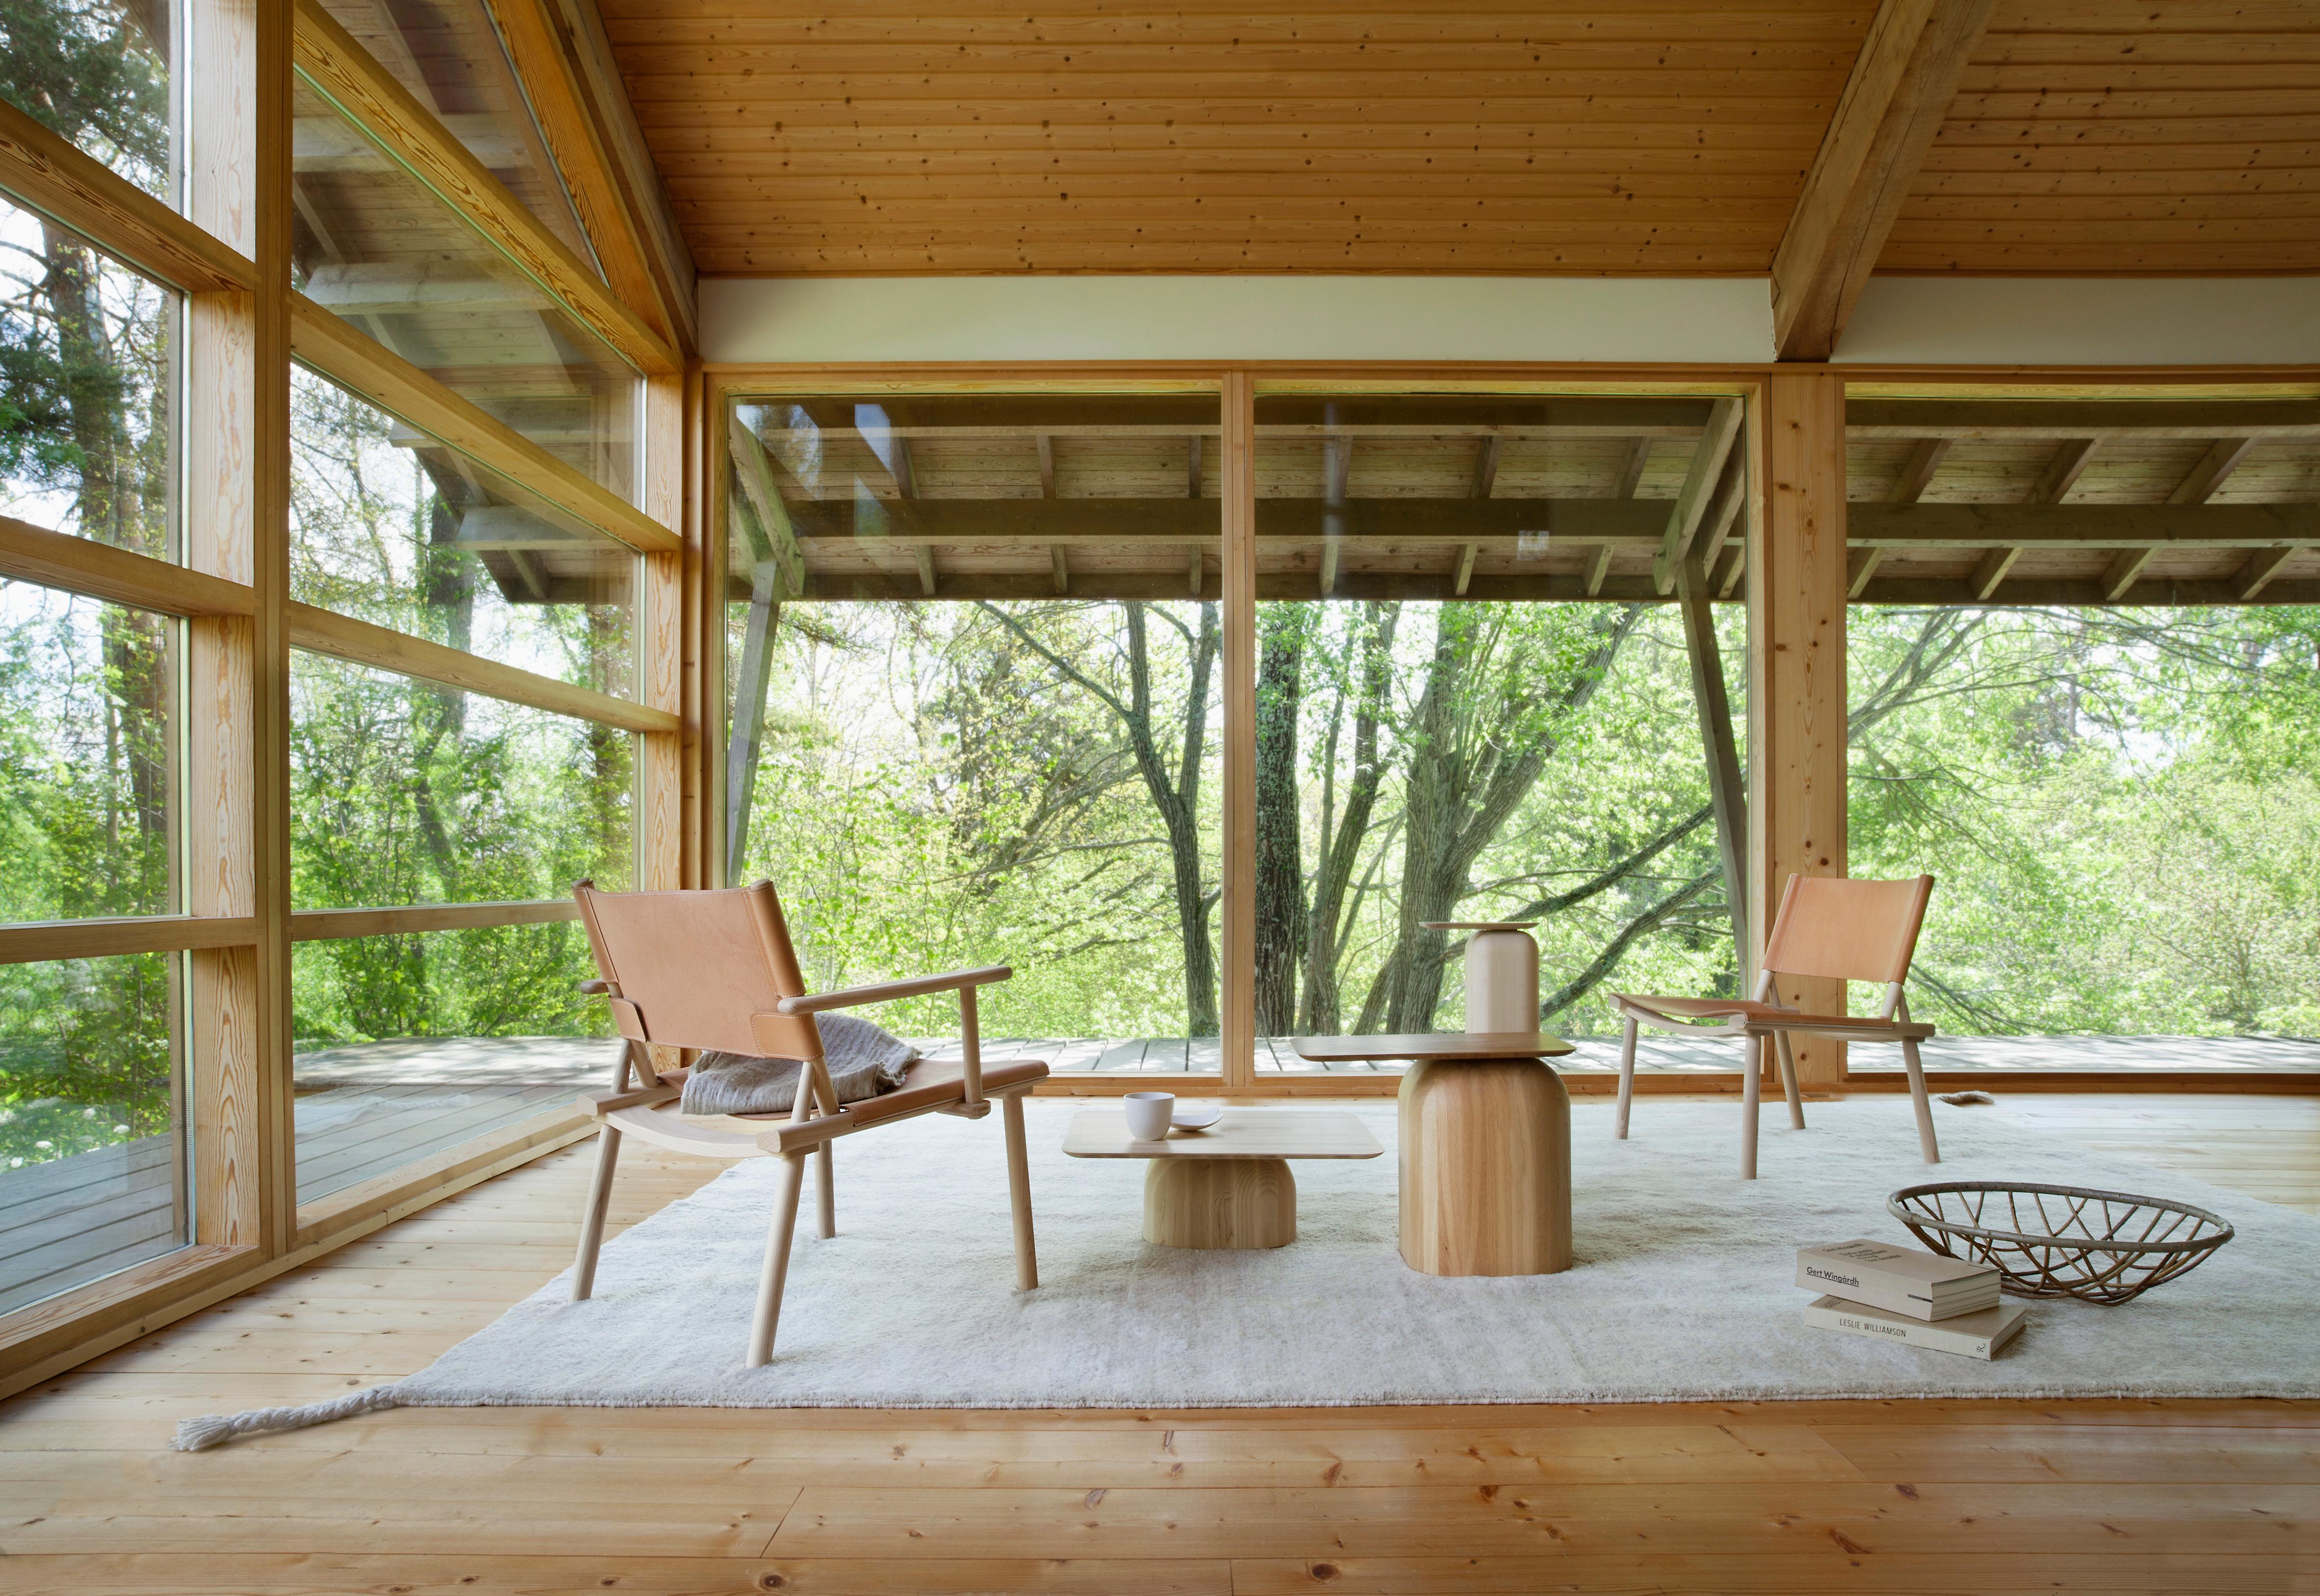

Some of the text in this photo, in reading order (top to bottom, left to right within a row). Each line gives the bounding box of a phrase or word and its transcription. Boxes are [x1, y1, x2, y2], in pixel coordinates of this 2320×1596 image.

[1807, 1266, 1859, 1286] Gert Wingårdh
[1840, 1318, 1906, 1337] LESLIE WILLIAMSON
